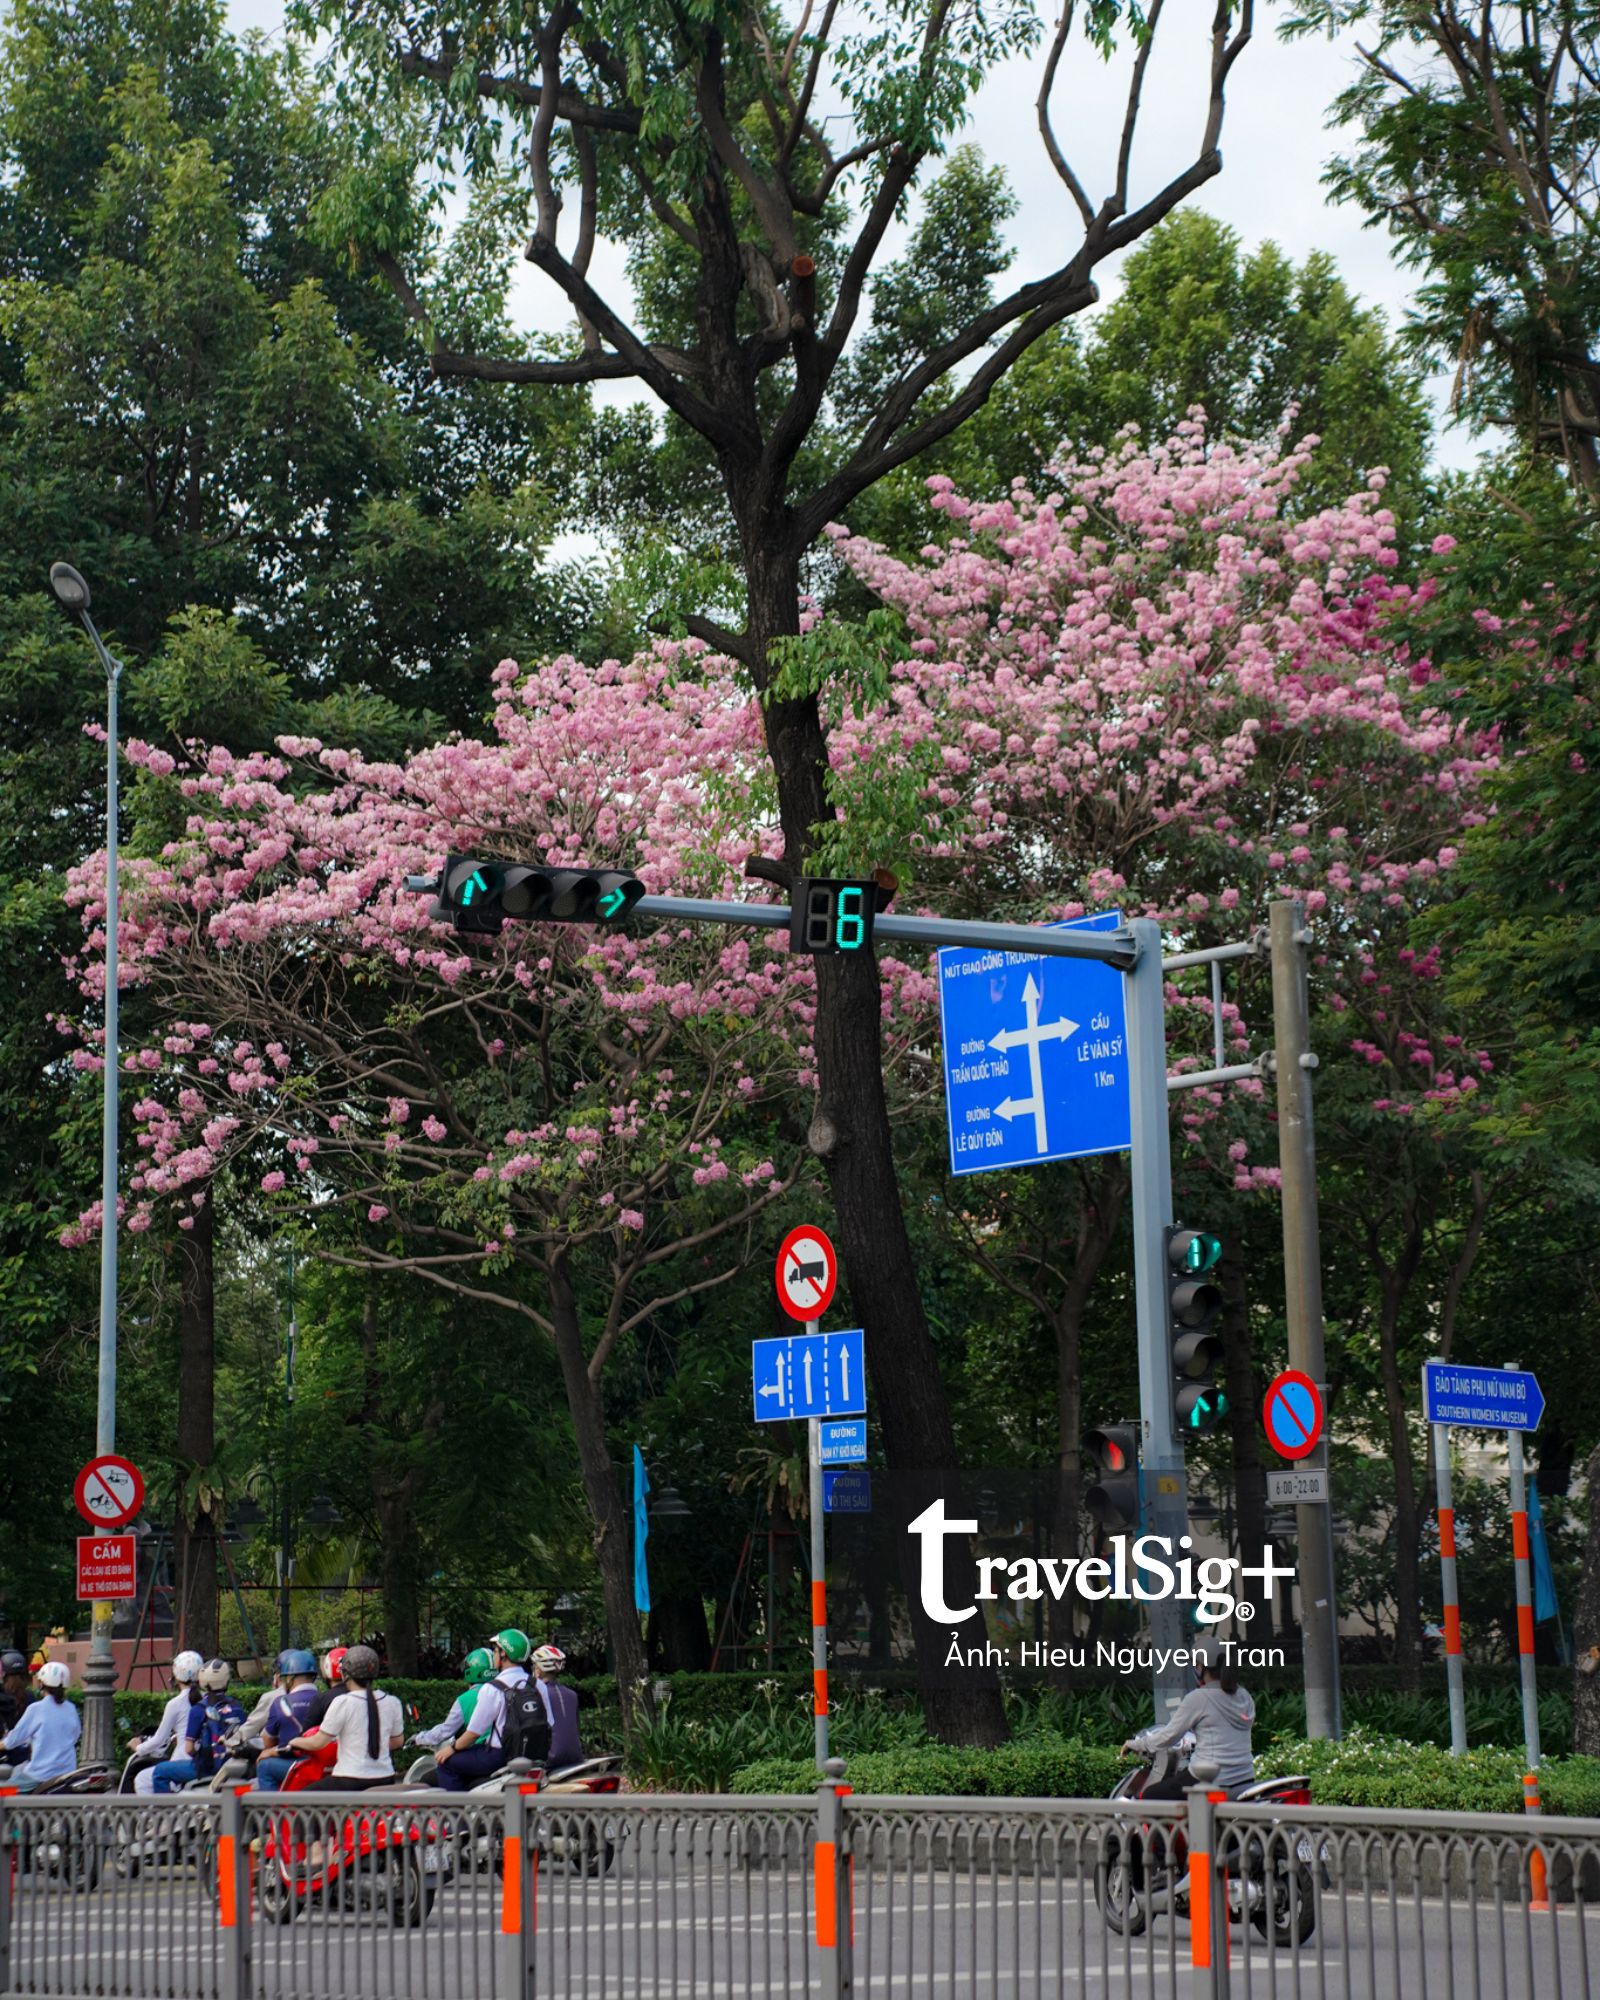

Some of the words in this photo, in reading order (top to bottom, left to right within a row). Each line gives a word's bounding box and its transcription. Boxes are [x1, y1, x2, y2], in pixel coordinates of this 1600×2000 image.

[944, 962, 960, 979] NÚT
[961, 960, 980, 975] GIAO
[981, 950, 1003, 971] CÔNG
[1077, 1041, 1090, 1062] LÊ
[1090, 1039, 1110, 1059] VĂN
[970, 1058, 990, 1081] QUỐC
[956, 1132, 967, 1152] LÊ
[985, 1128, 1003, 1148] ĐÔN
[1435, 1369, 1450, 1393] BẢO
[1450, 1372, 1470, 1395] TÀNG
[1471, 1379, 1486, 1400] PHỤ
[1499, 1382, 1515, 1399] NAM
[1516, 1380, 1526, 1404] BỘ
[1436, 1404, 1470, 1420] SOUTHERN
[1471, 1408, 1500, 1422] WOMEN'S
[1501, 1411, 1528, 1425] MUSEUM
[93, 1539, 121, 1559] CẤM
